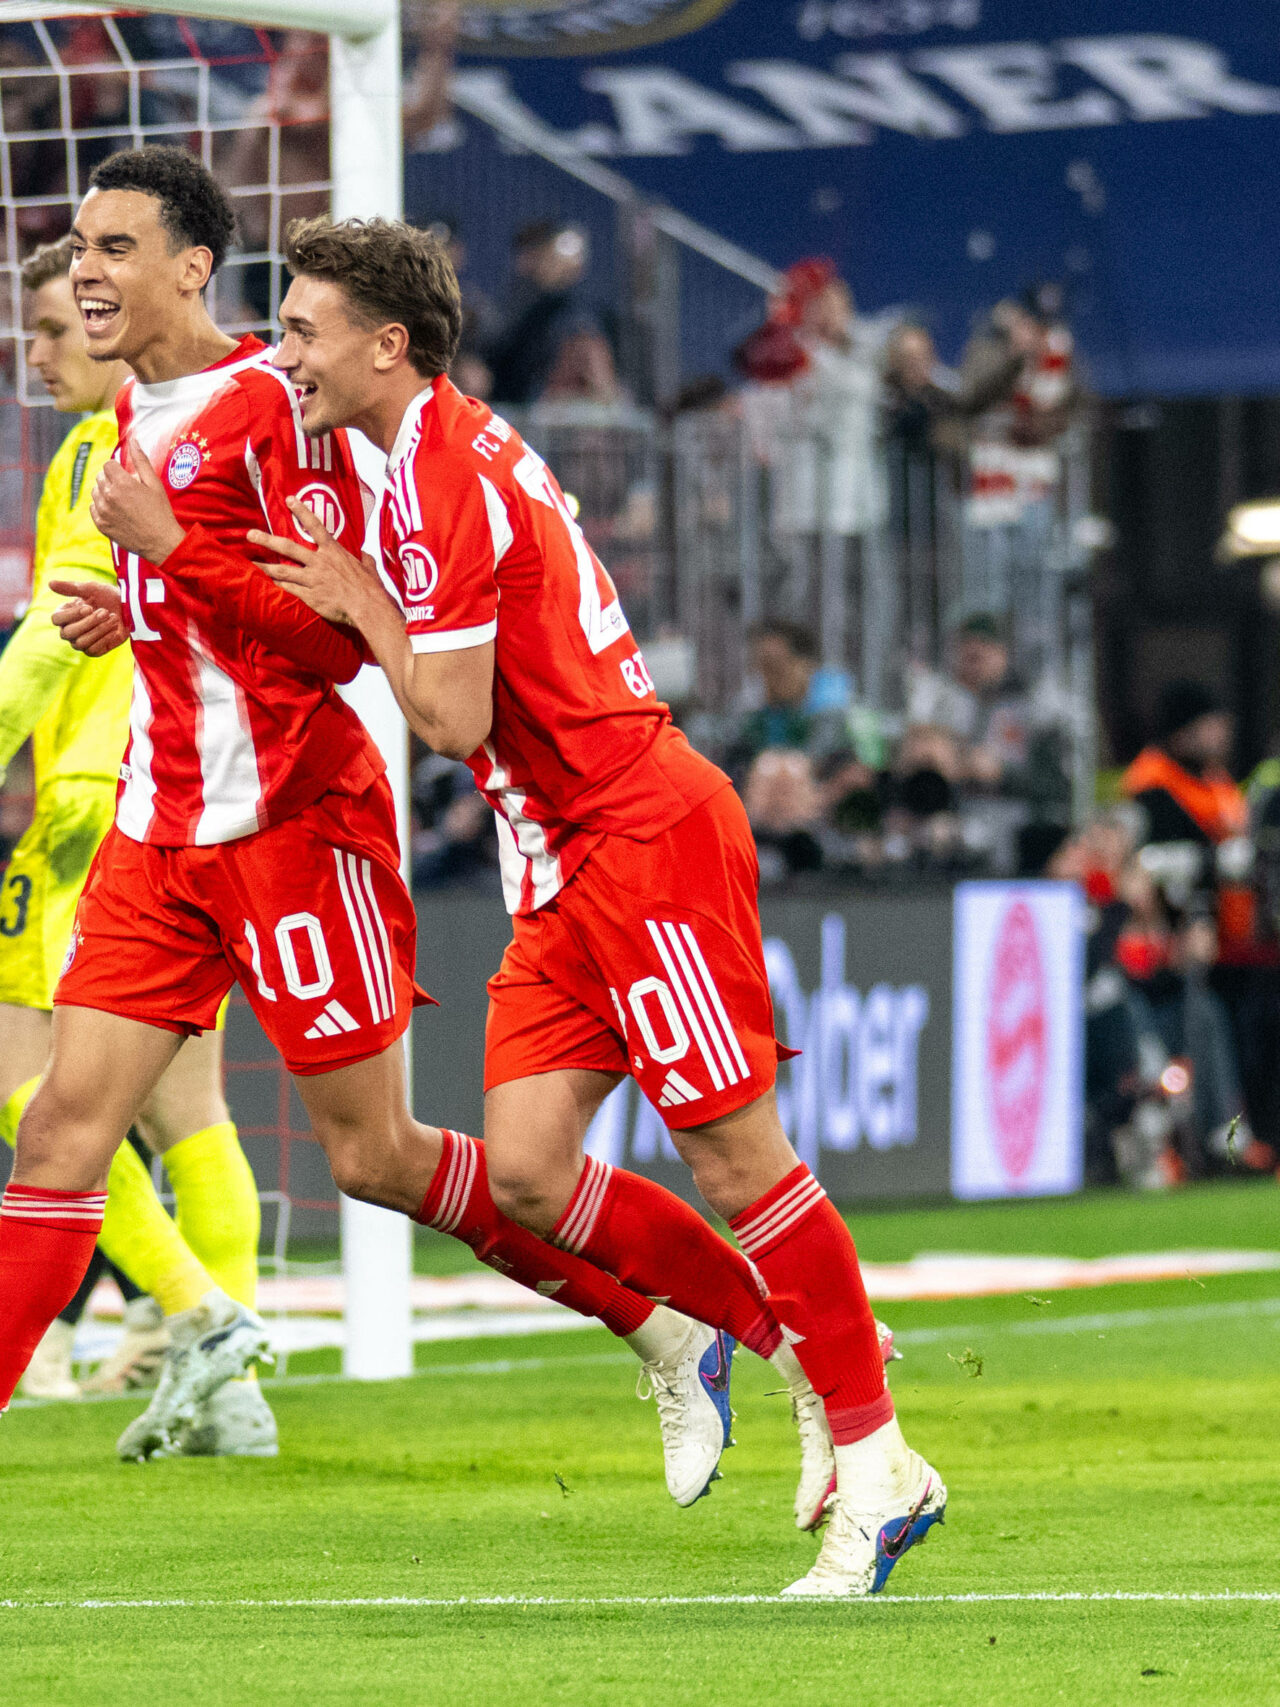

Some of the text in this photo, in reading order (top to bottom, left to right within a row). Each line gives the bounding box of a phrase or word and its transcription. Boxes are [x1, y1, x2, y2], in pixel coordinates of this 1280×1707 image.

[410, 32, 1280, 156] LANER
[471, 433, 501, 462] FC
[244, 911, 335, 1002] 10
